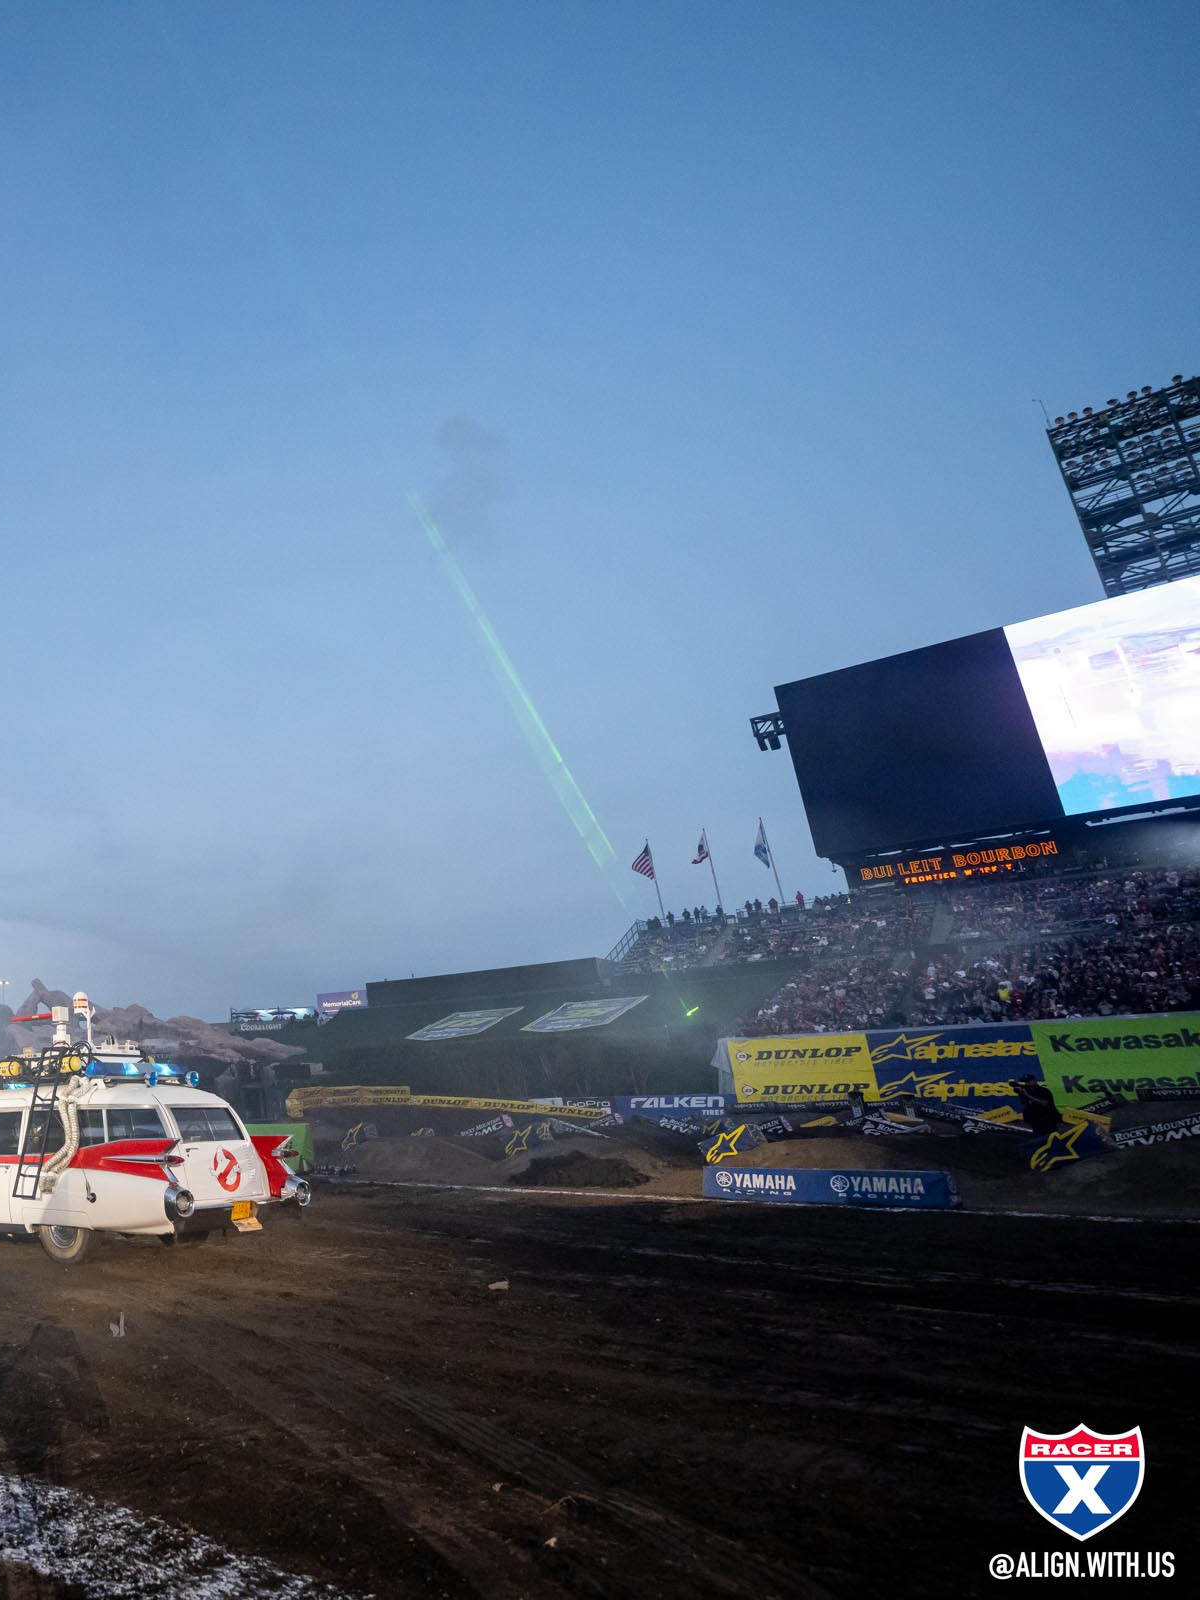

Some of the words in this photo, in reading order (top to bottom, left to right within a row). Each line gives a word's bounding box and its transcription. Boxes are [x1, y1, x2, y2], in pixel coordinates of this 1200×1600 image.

[952, 841, 1059, 867] BOURBON
[904, 871, 957, 884] FRONTIER
[322, 1000, 362, 1008] MemorialCare
[1050, 1027, 1200, 1052] Kawasak
[754, 1046, 863, 1061] DUNLOP
[913, 1040, 1037, 1063] alpinestars
[760, 1083, 871, 1096] DUNLOP
[1060, 1073, 1200, 1093] Kawasa
[422, 1098, 470, 1106] DUNLOP
[482, 1101, 535, 1110] DUNLOP
[566, 1100, 611, 1108] GoPro
[630, 1096, 725, 1109] FALKEN
[549, 1107, 605, 1118] DUNLOP
[1114, 1130, 1149, 1142] ROCKY
[733, 1173, 797, 1190] YAMAHA
[850, 1175, 925, 1194] YAMAHA
[722, 1187, 793, 1196] RACING
[837, 1192, 921, 1200] RACING
